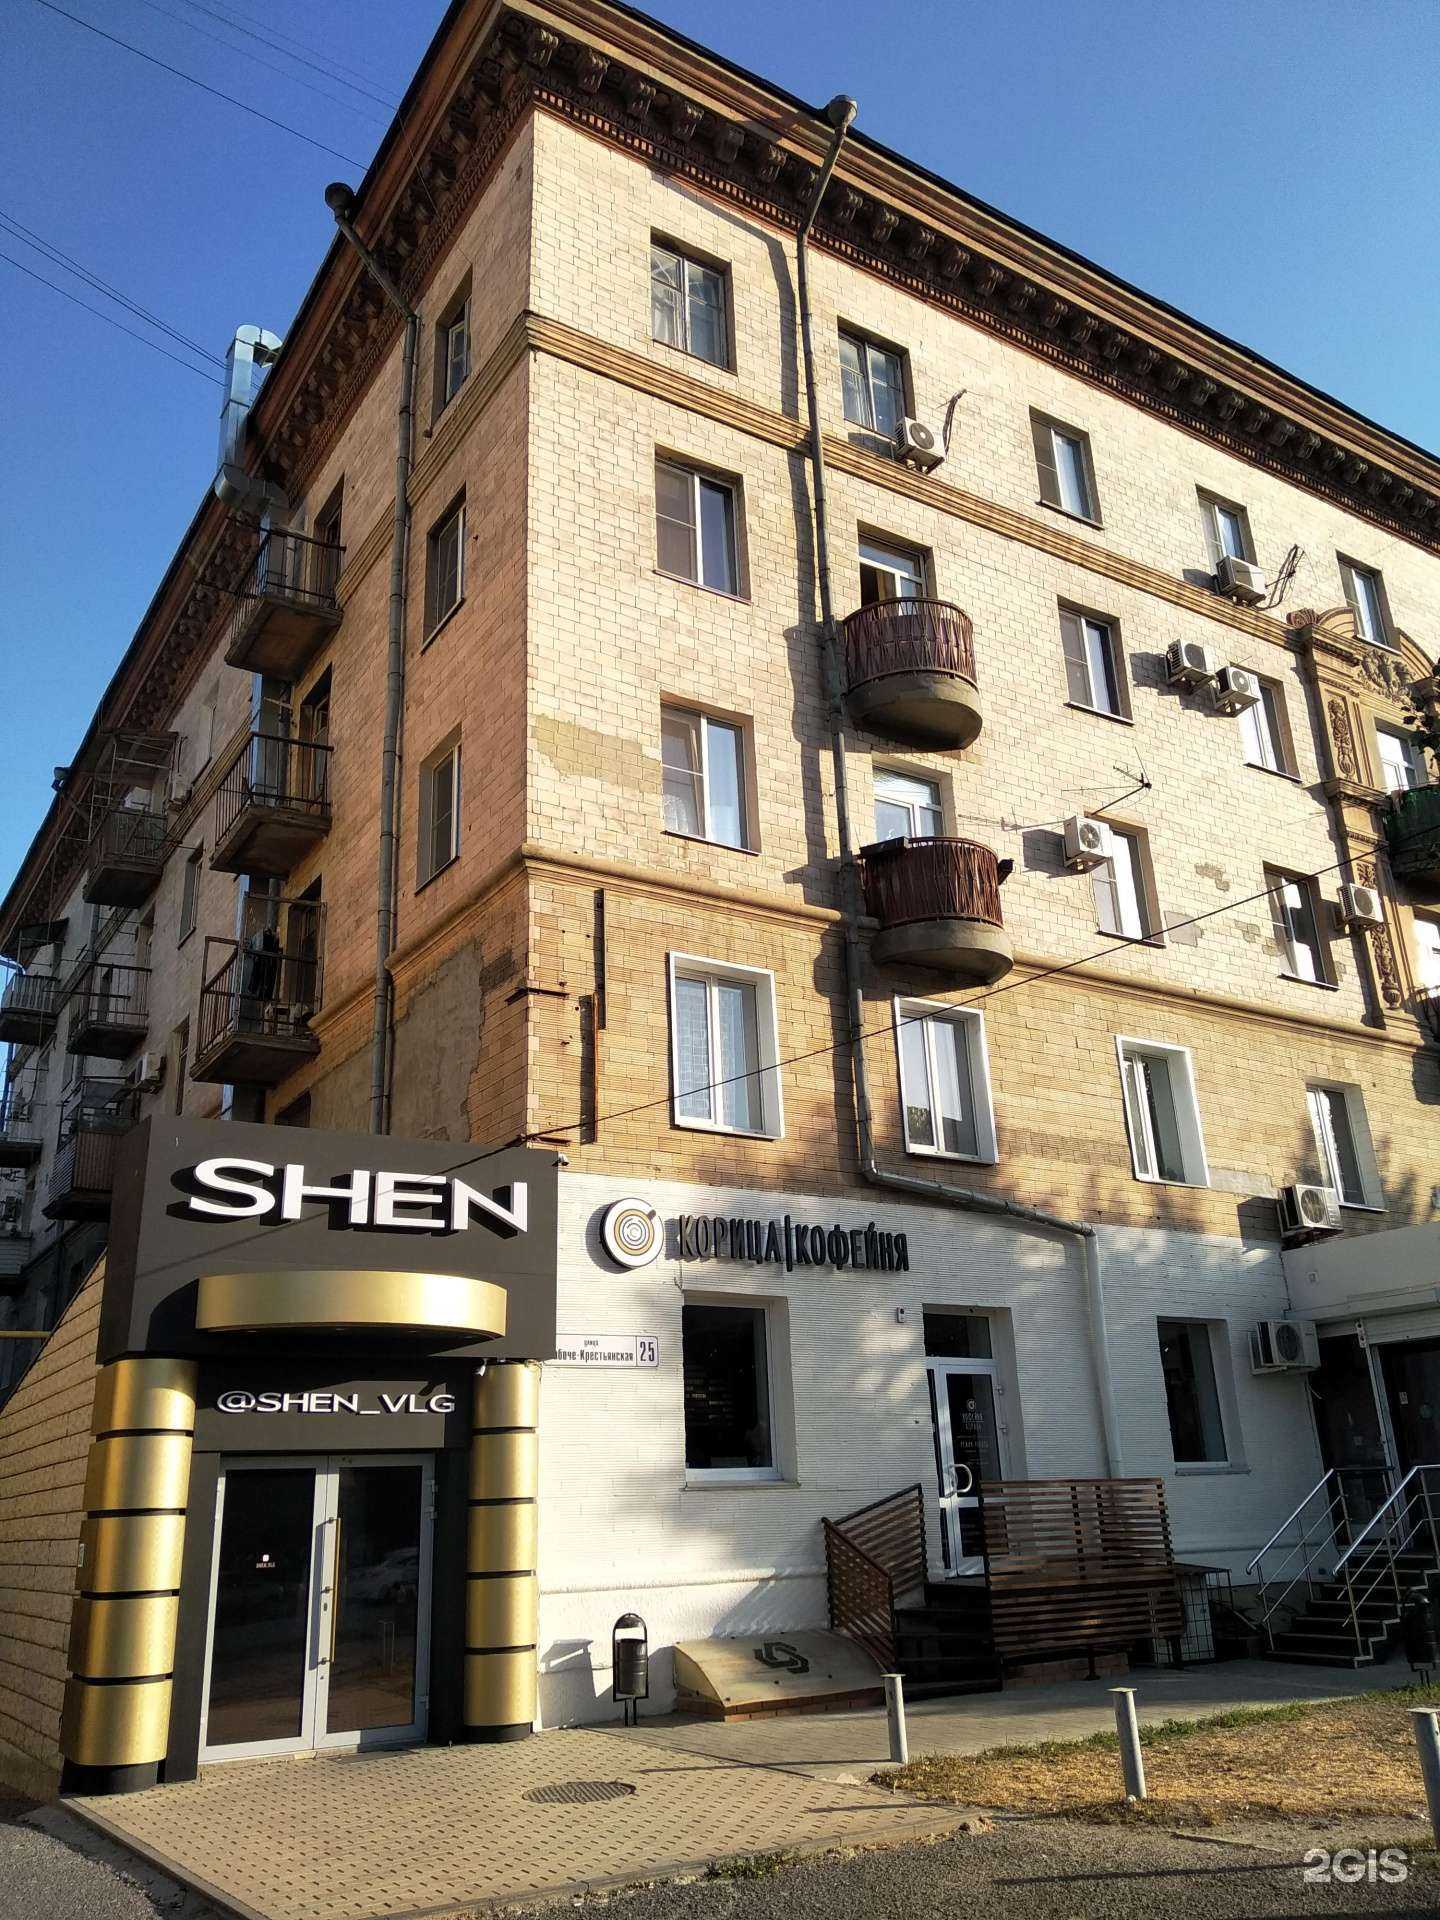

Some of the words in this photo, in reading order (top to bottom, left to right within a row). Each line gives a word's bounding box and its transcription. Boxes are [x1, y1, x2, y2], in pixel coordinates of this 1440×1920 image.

[189, 1157, 528, 1232] SHEN
[679, 1214, 781, 1264] КОРИЦА
[795, 1222, 909, 1271] КОФЕЙНЯ
[555, 1348, 634, 1363] боче-Крестьянская
[640, 1341, 655, 1362] 25
[217, 1390, 455, 1414] @SHEN_VLG
